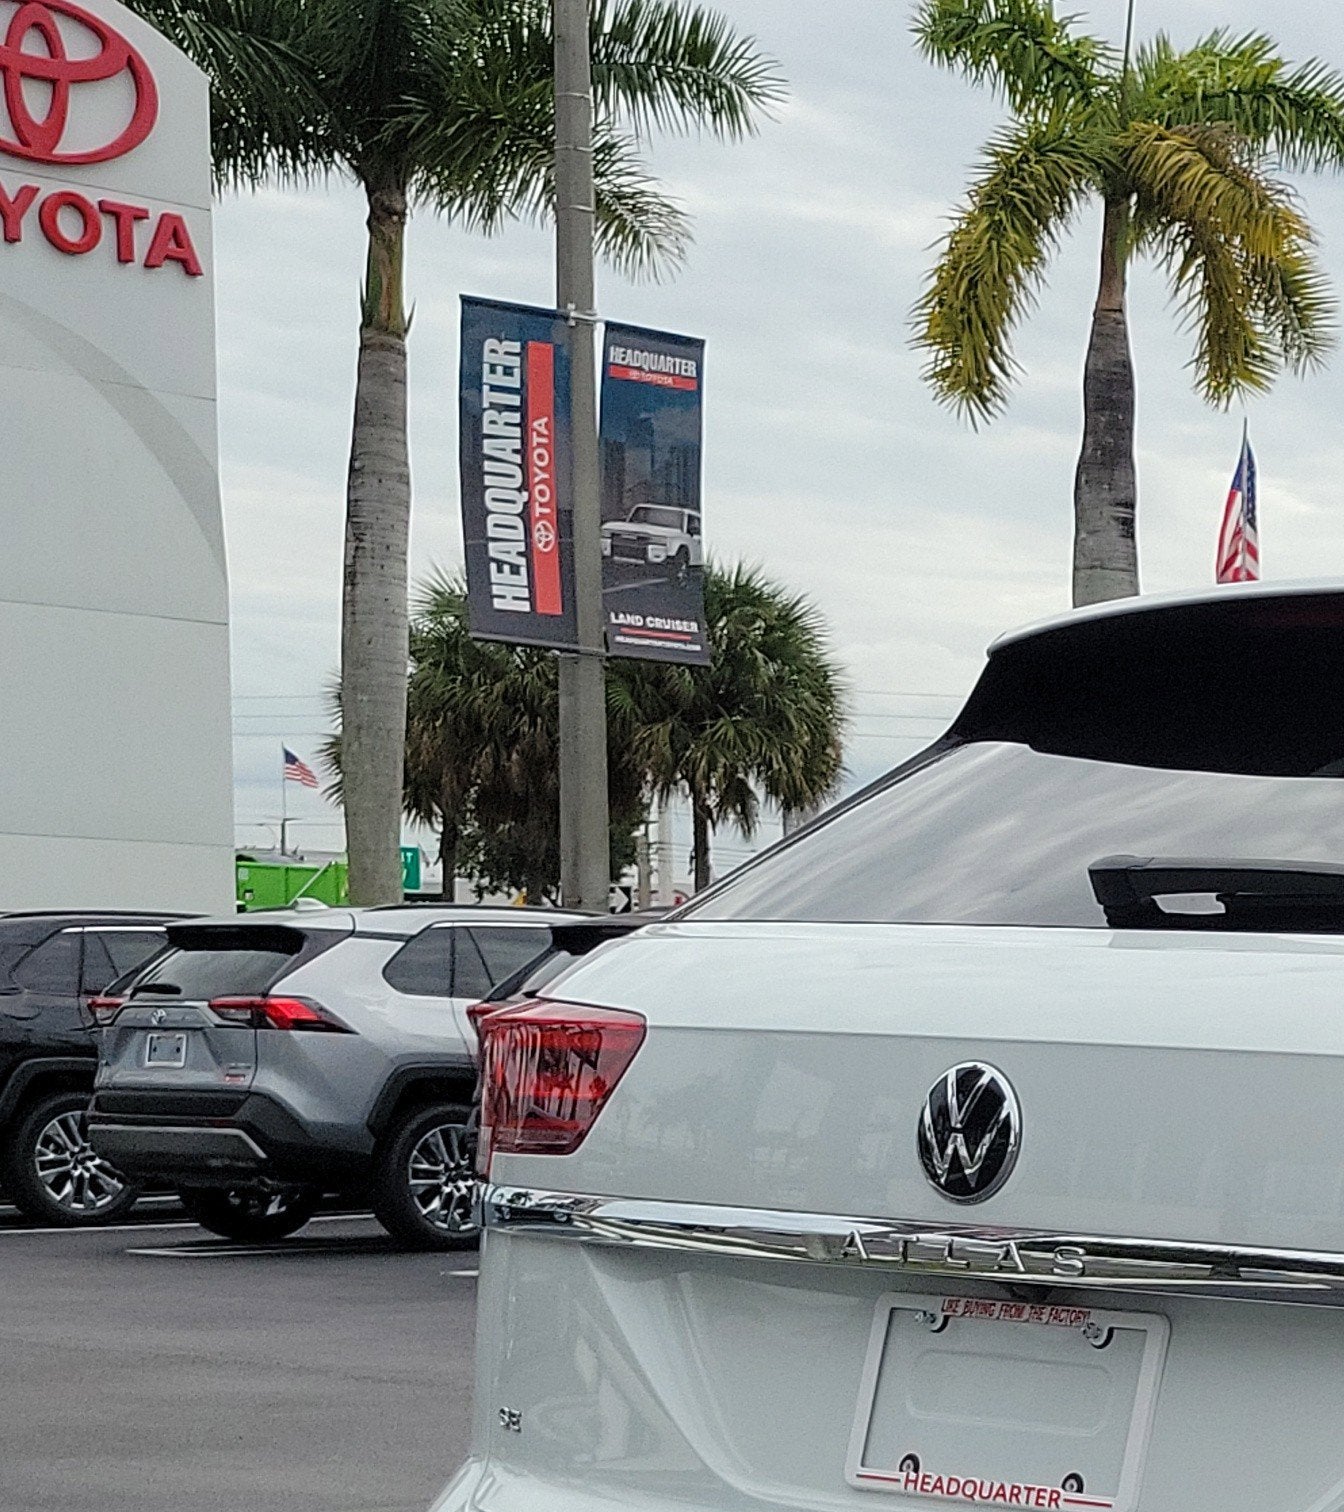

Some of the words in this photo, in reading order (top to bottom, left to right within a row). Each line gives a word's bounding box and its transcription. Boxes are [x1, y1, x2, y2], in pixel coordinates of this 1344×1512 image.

[609, 345, 697, 377] HEADQUARTER
[482, 338, 532, 612] HEADQUARTER
[531, 417, 552, 516] TOYOTA
[610, 611, 644, 627] LAND
[646, 616, 699, 633] CRUISER
[841, 1229, 1085, 1277] ATLAS
[903, 1472, 1061, 1509] HEADQUARTER
